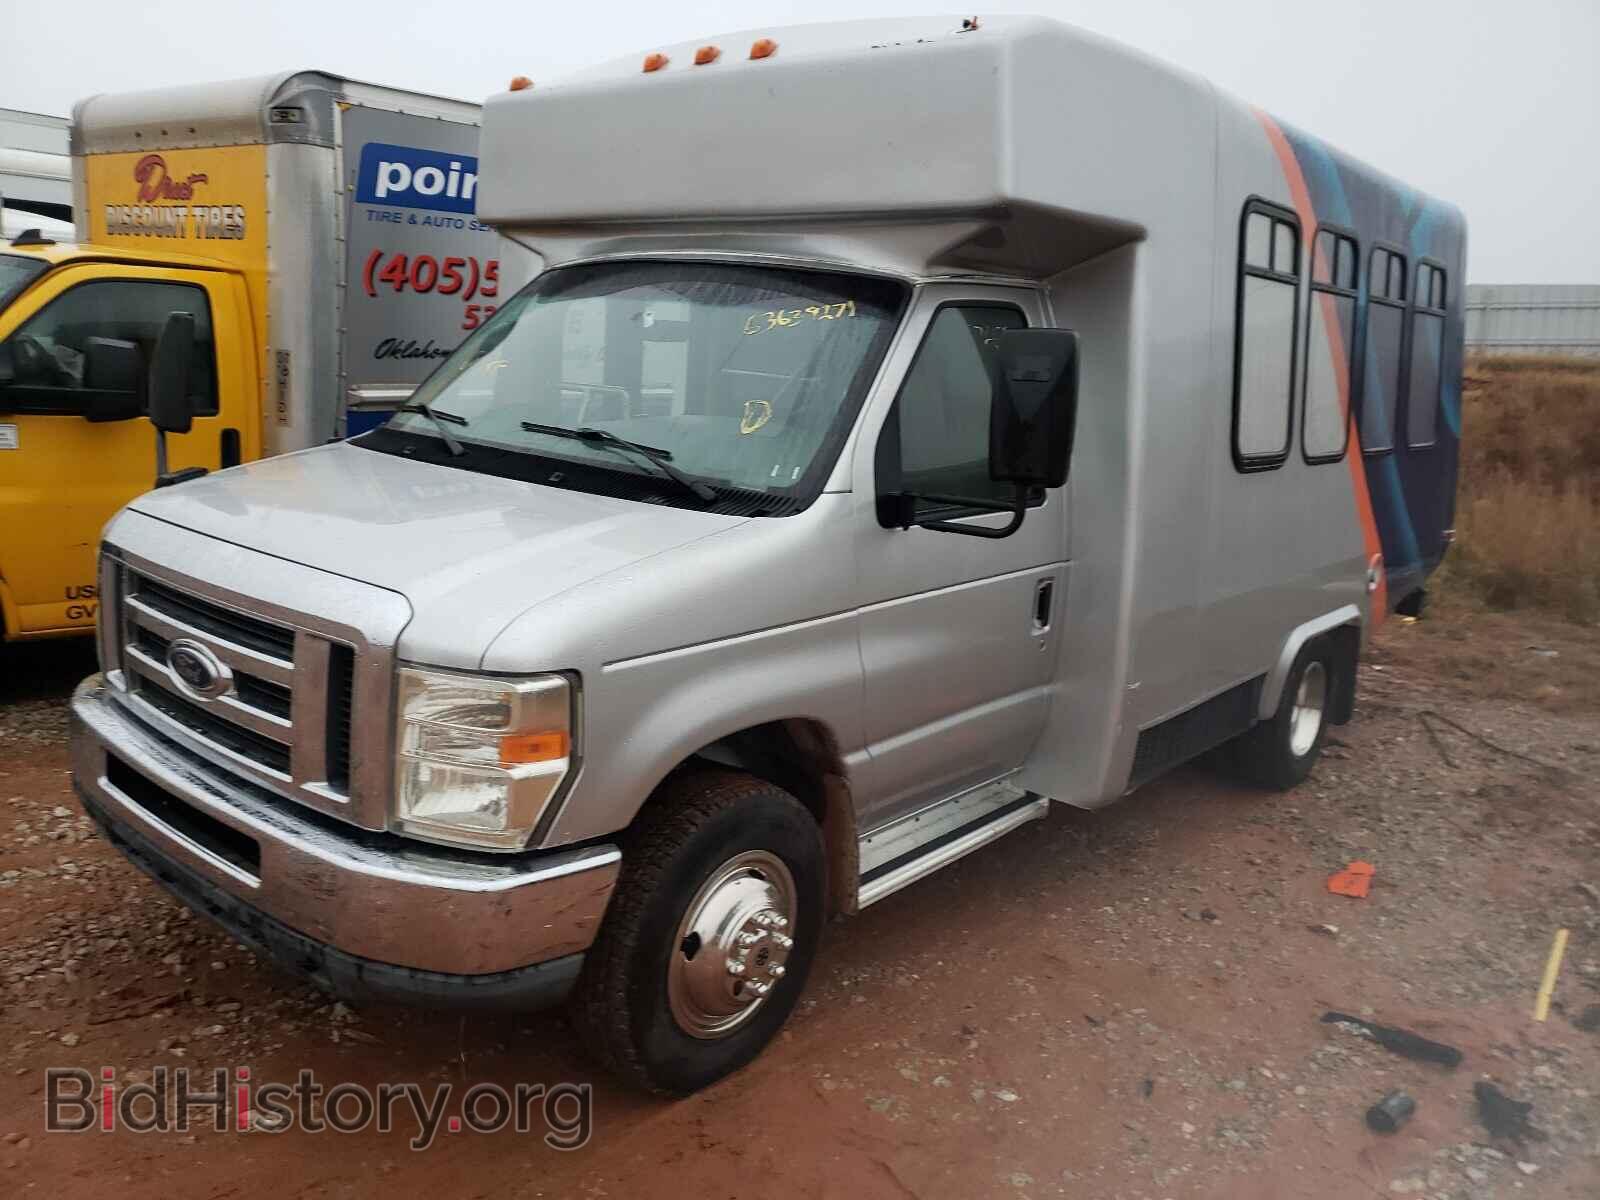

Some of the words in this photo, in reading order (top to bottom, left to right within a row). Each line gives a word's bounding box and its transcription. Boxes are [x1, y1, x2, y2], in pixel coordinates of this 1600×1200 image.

[105, 204, 188, 239] DISCOUNT
[191, 204, 246, 240] TIRES
[366, 210, 403, 224] TIRE
[408, 213, 418, 225] &
[422, 215, 465, 230] AUTO
